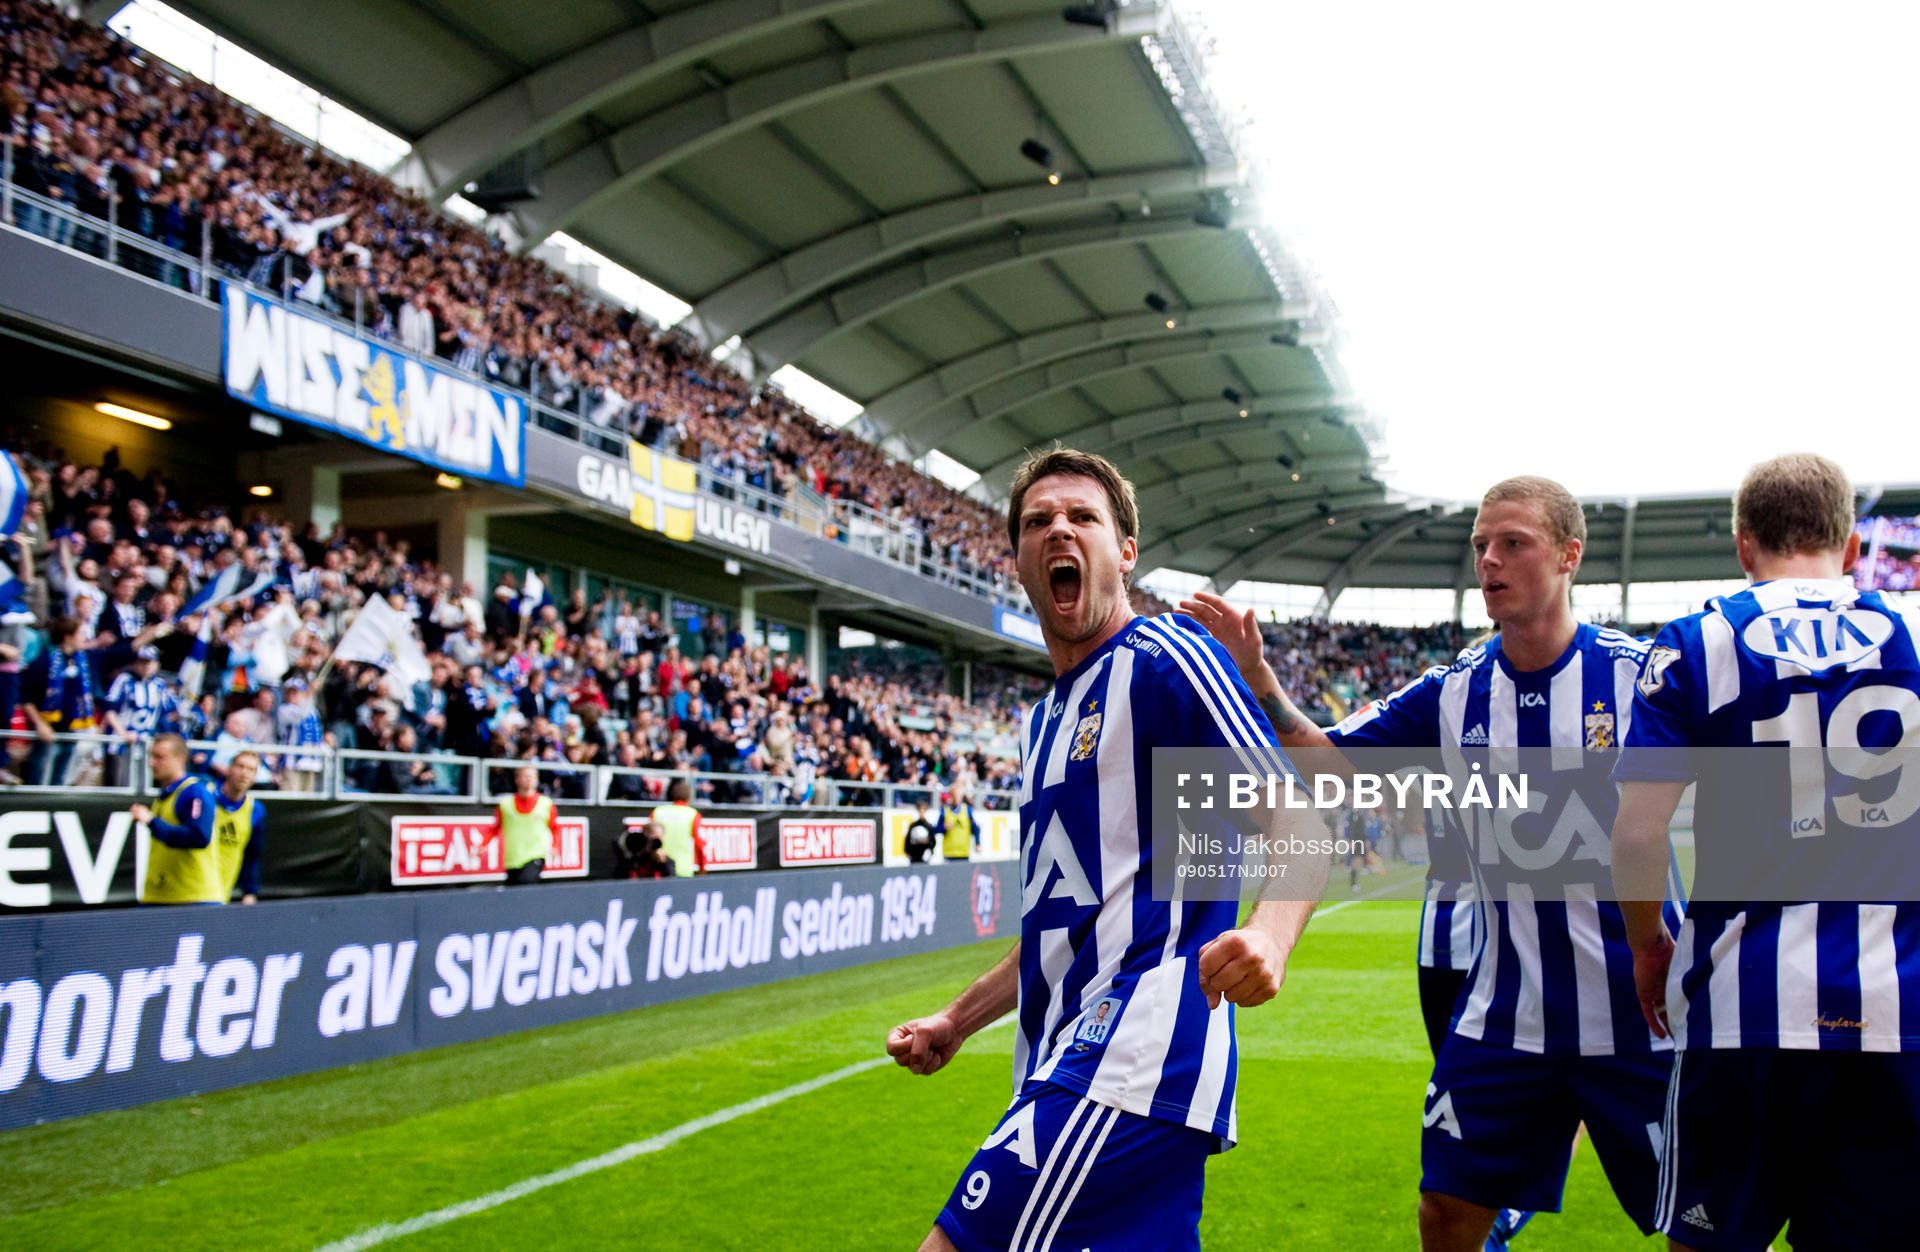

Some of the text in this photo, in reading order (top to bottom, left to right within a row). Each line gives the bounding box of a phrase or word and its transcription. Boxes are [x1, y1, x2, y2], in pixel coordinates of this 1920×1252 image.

[227, 286, 520, 479] WISE MEN
[696, 496, 771, 555] ULLEVI
[1768, 613, 1876, 659] KIA
[1519, 692, 1547, 708] ICA
[1461, 736, 1490, 746] adidas
[1752, 684, 1920, 840] 19
[1477, 787, 1612, 871] ICA
[1793, 817, 1823, 834] ICA
[1861, 807, 1890, 823] ICA
[783, 827, 832, 859] TEAM
[318, 940, 418, 1038] av
[429, 898, 638, 1019] svensk
[646, 886, 777, 982] fotboll
[780, 880, 874, 960] sedan
[880, 873, 938, 943] 1934
[961, 1170, 991, 1210] 9
[1680, 1213, 1714, 1231] adidas
